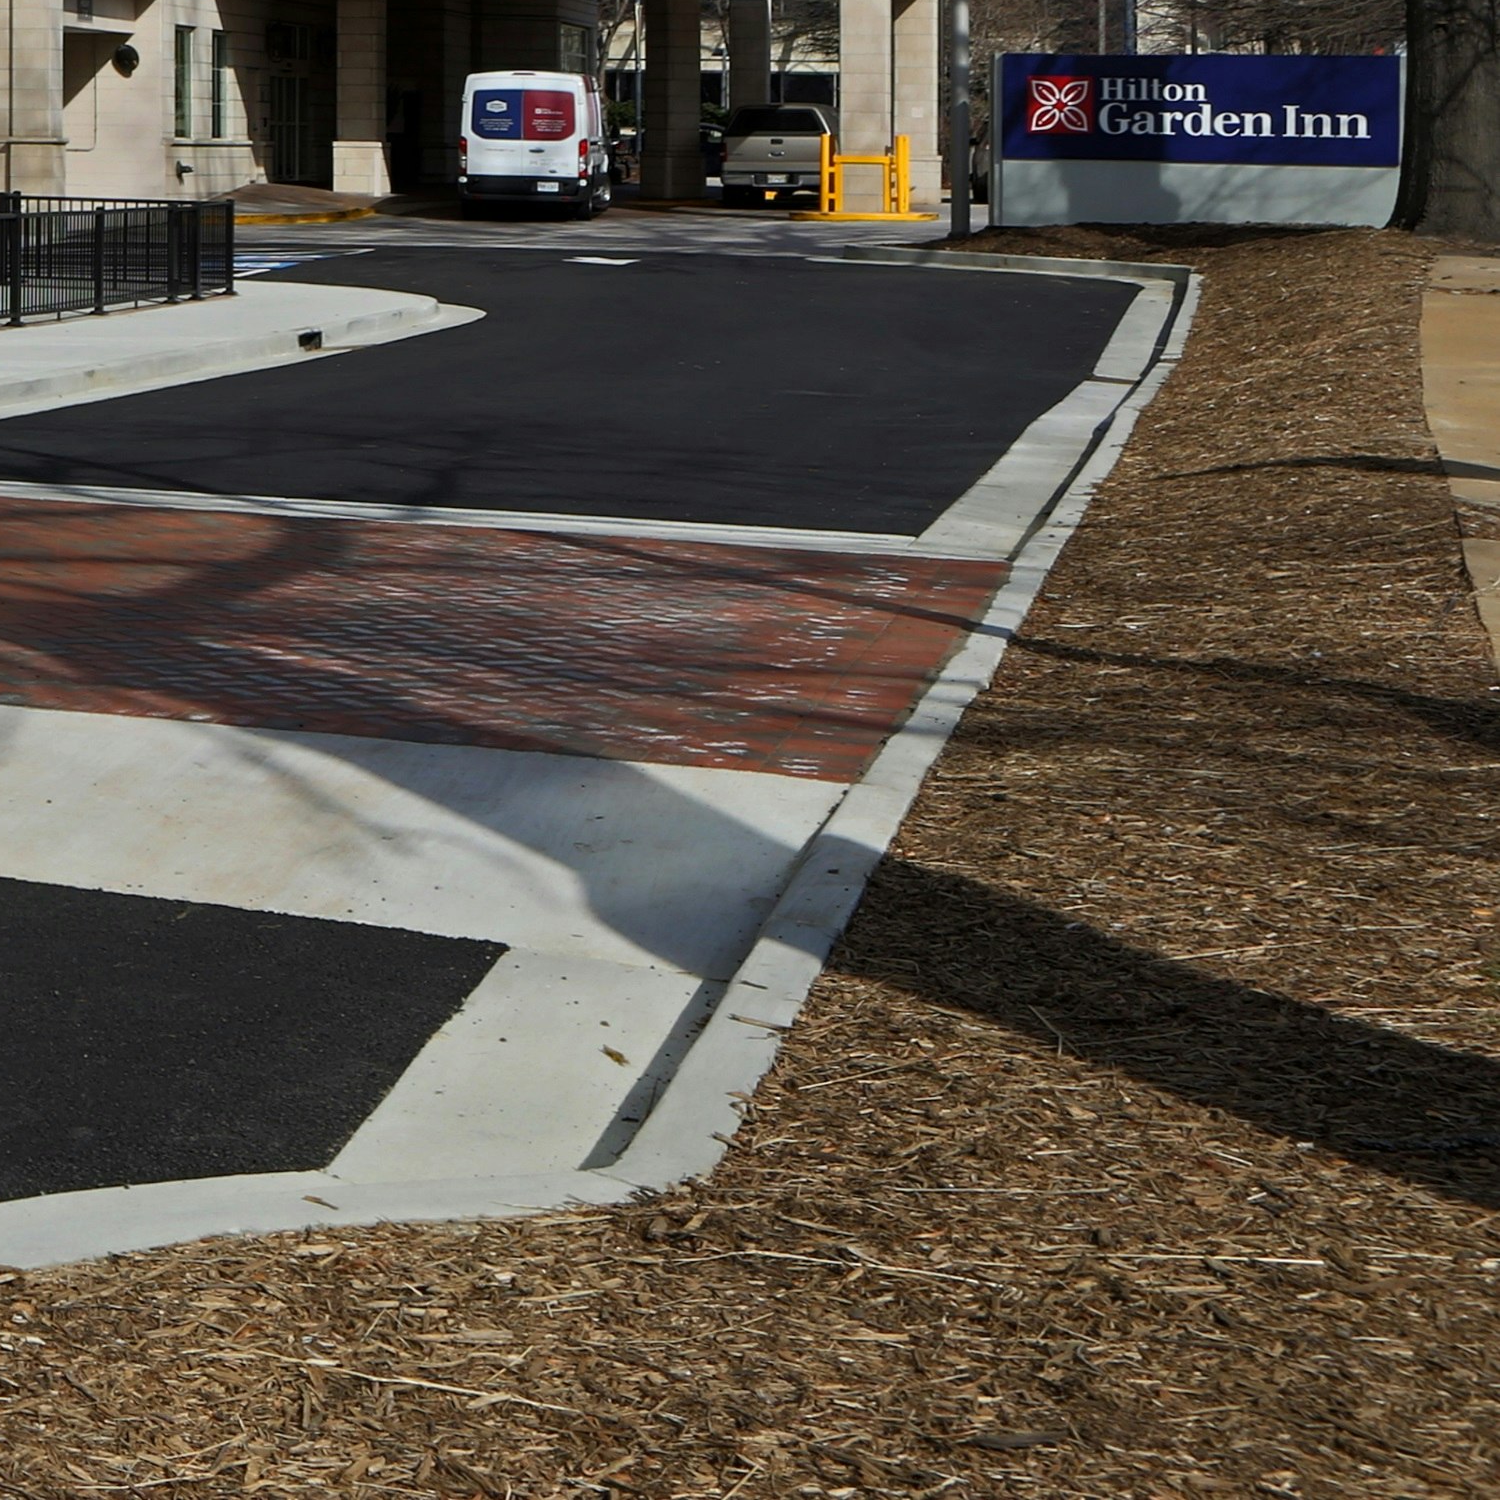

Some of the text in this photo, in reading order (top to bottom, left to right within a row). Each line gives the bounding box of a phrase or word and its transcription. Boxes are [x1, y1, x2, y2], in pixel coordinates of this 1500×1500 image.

[1100, 77, 1208, 102] Hilton
[1098, 102, 1371, 139] Garden Inn
